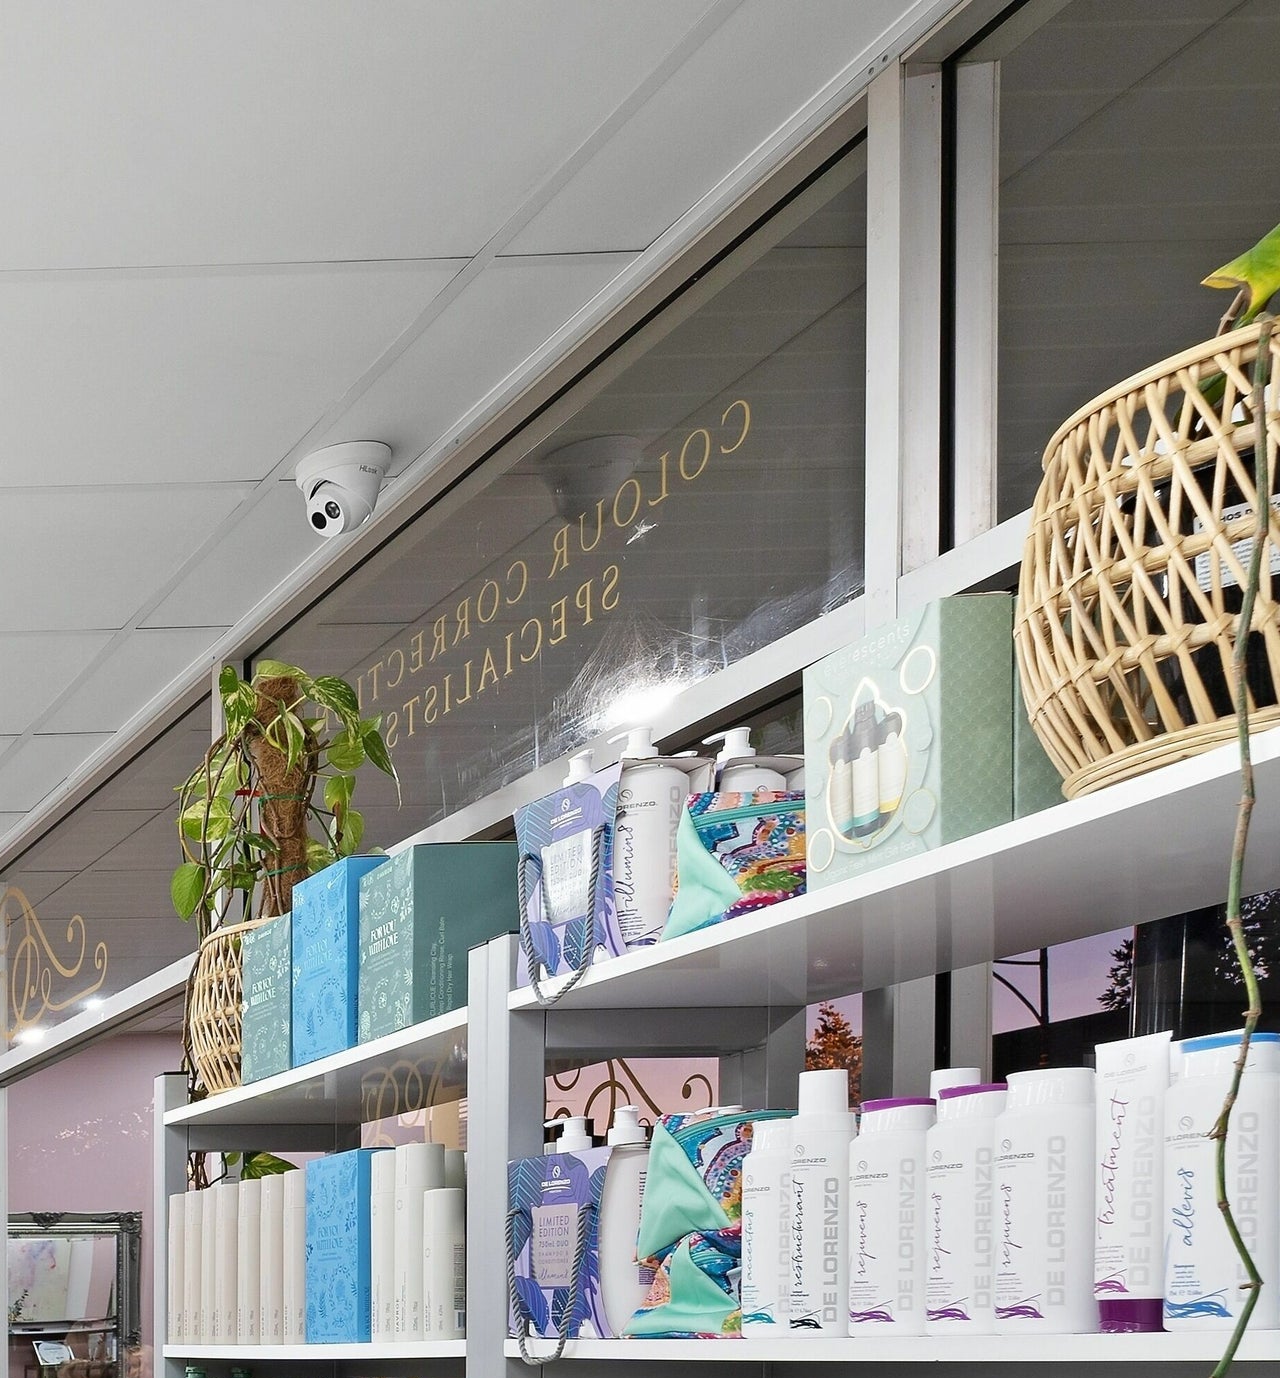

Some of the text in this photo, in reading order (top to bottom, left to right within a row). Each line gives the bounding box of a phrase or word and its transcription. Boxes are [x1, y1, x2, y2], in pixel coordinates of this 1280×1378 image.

[539, 1215, 569, 1227] LIMITED
[539, 1227, 569, 1238] EDITION
[897, 1157, 916, 1312] DE LORENZO
[975, 1147, 992, 1268] LORENZO
[1047, 1135, 1067, 1307] DE LORENZO
[1130, 1095, 1156, 1239] LORENZO
[823, 1177, 839, 1323] DE LORENZO
